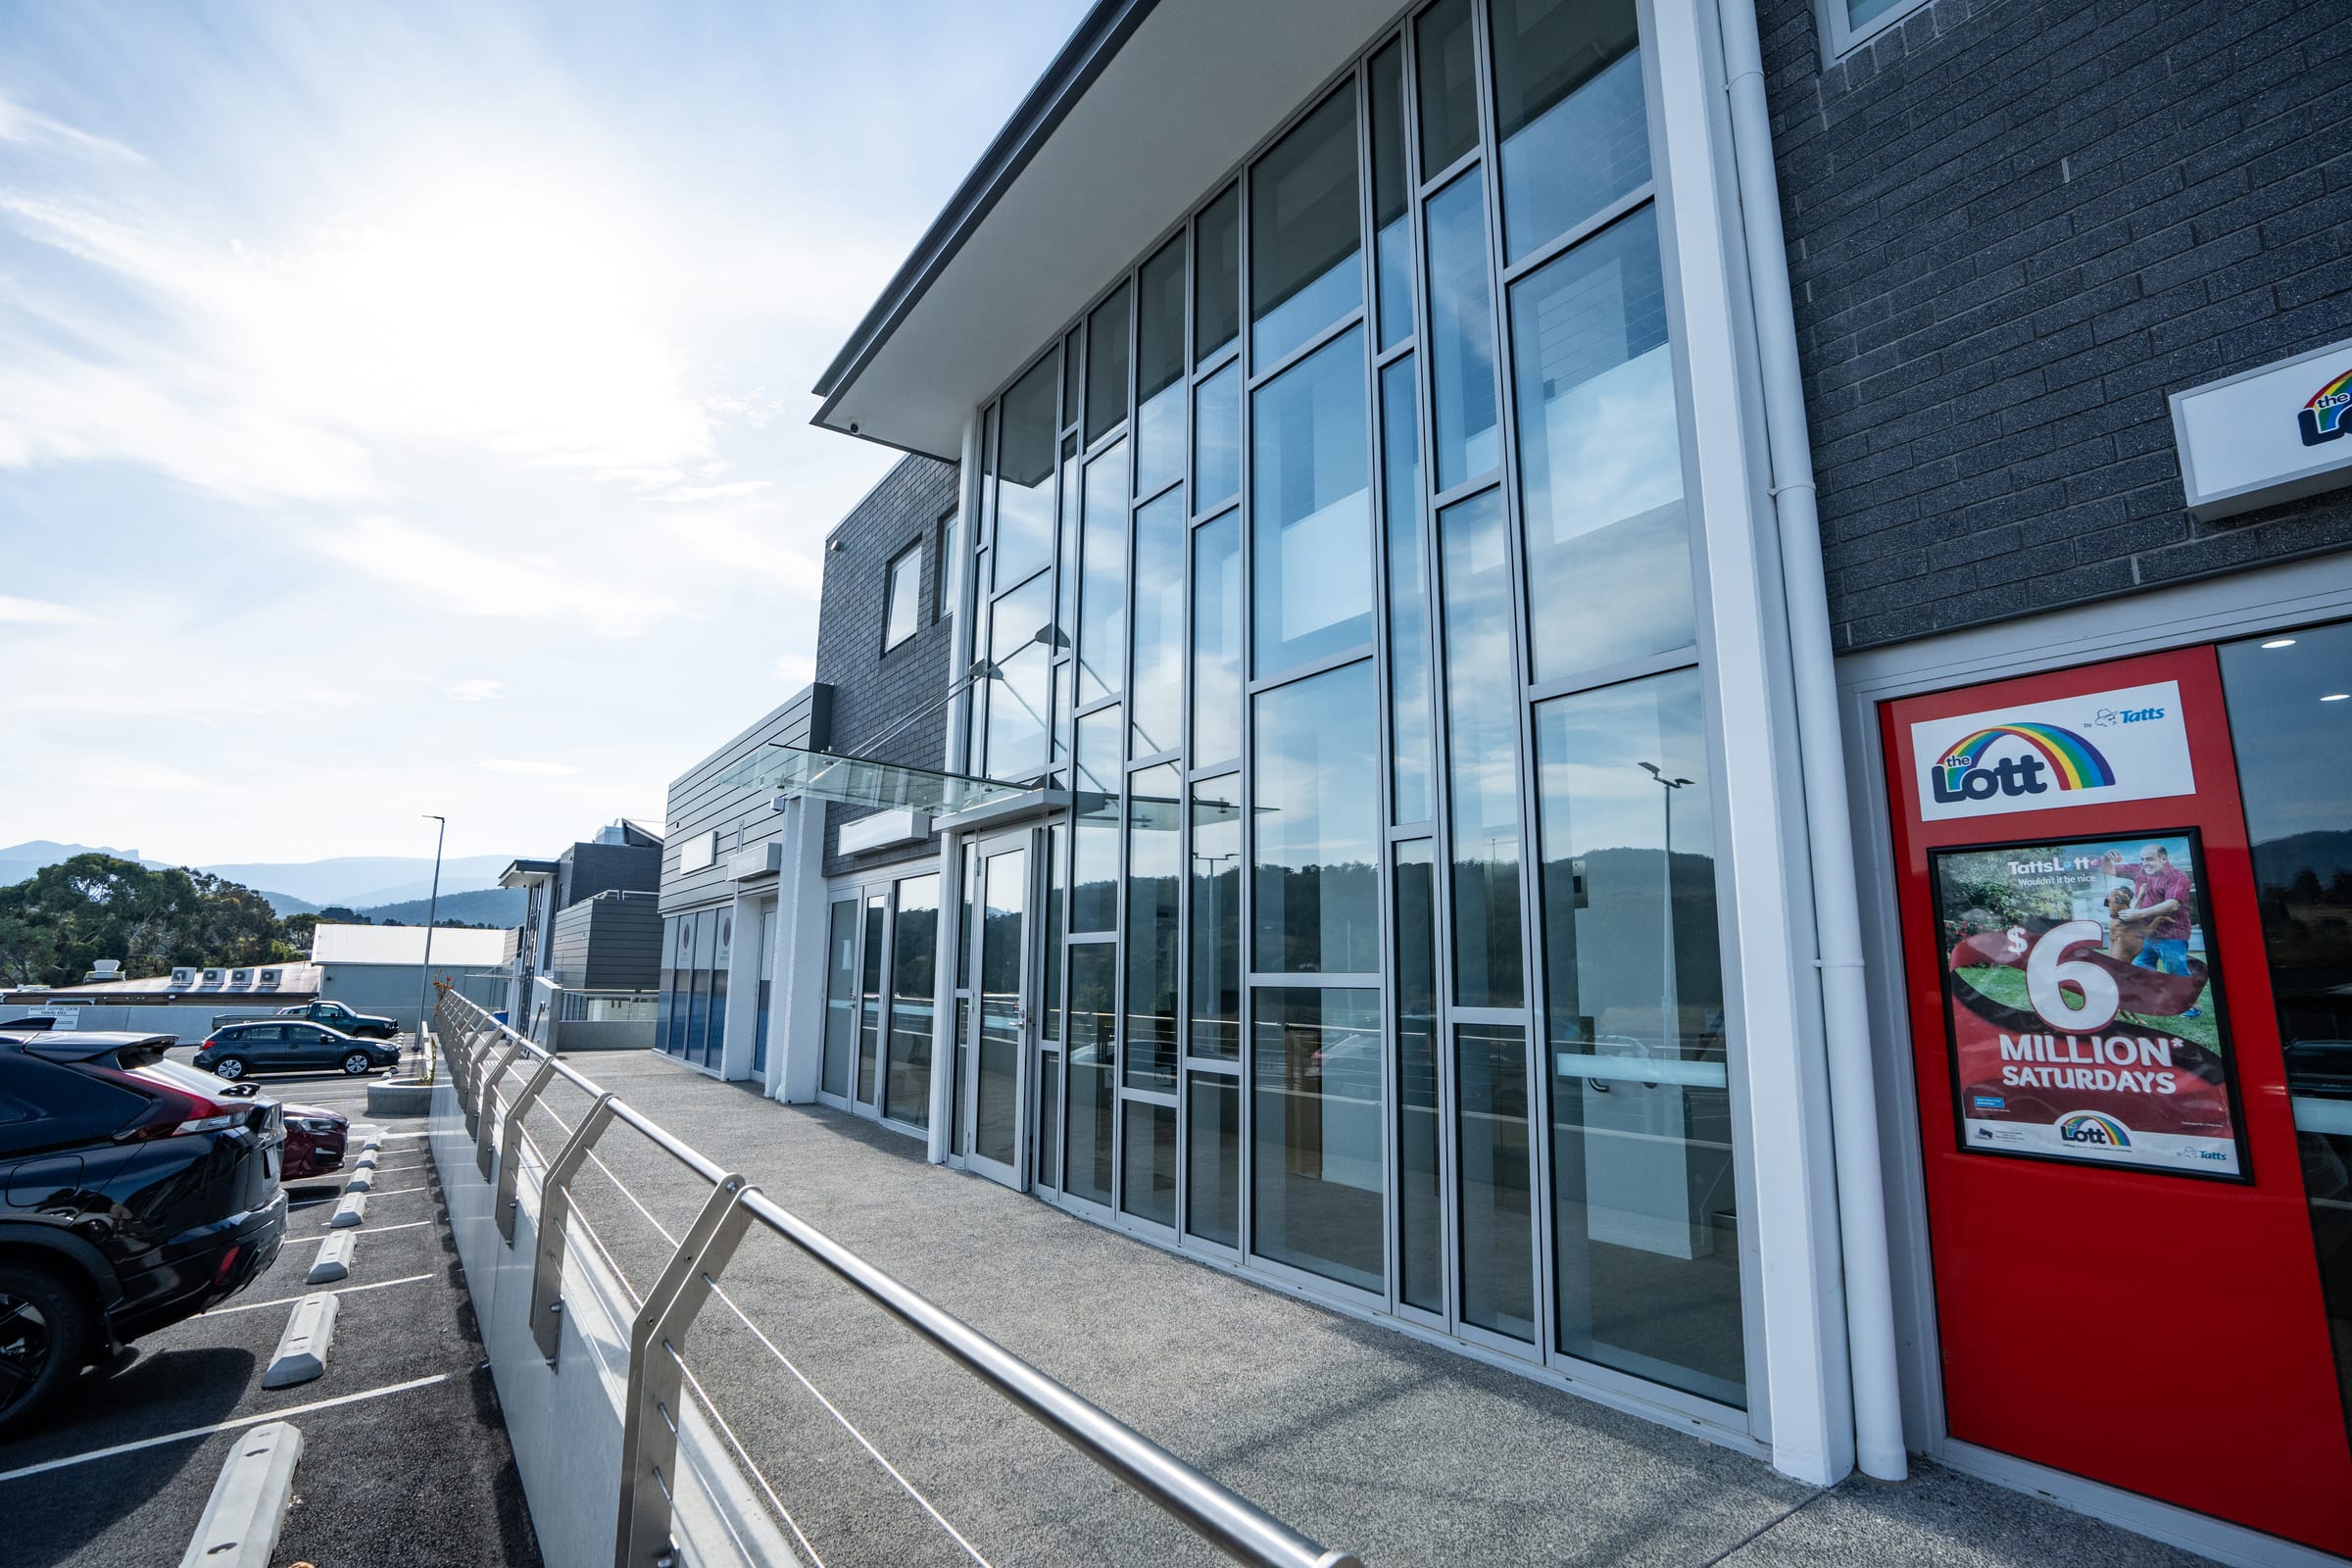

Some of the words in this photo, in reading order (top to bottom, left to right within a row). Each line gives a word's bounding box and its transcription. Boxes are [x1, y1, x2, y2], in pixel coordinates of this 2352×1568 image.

[2317, 393, 2349, 409] the
[2120, 708, 2165, 724] Tatts
[1946, 755, 1970, 767] the
[1932, 755, 2048, 804] Lott
[2064, 875, 2076, 884] be
[2078, 873, 2096, 883] nice
[2002, 1065, 2178, 1095] SATURDAYS
[2060, 1125, 2107, 1145] Lott
[2199, 1151, 2228, 1160] Tatts
